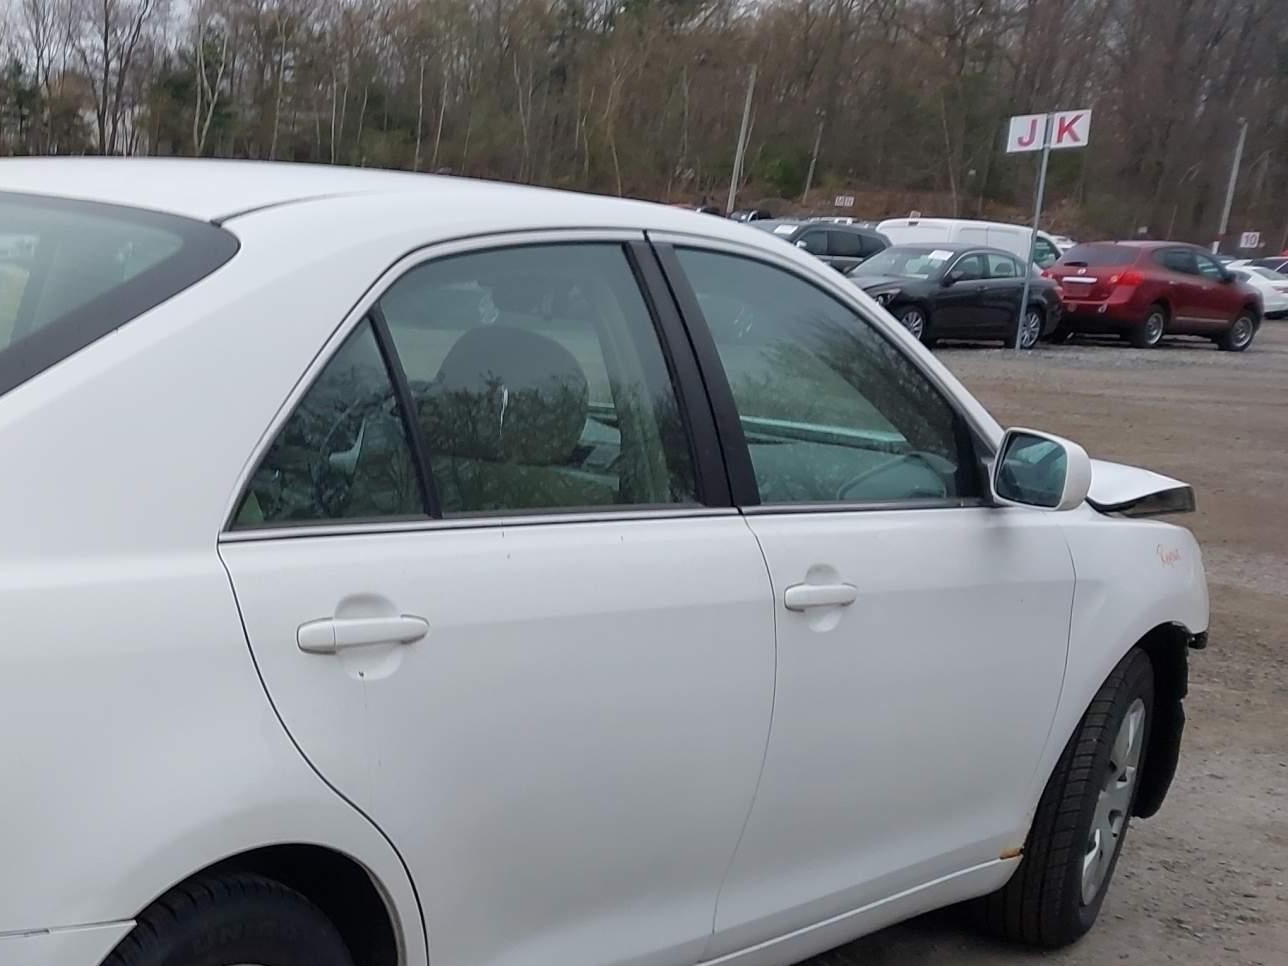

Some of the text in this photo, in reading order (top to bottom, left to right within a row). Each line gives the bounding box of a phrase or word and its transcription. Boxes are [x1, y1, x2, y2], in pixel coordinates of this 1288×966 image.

[1017, 113, 1084, 147] J K
[1244, 233, 1257, 246] 10
